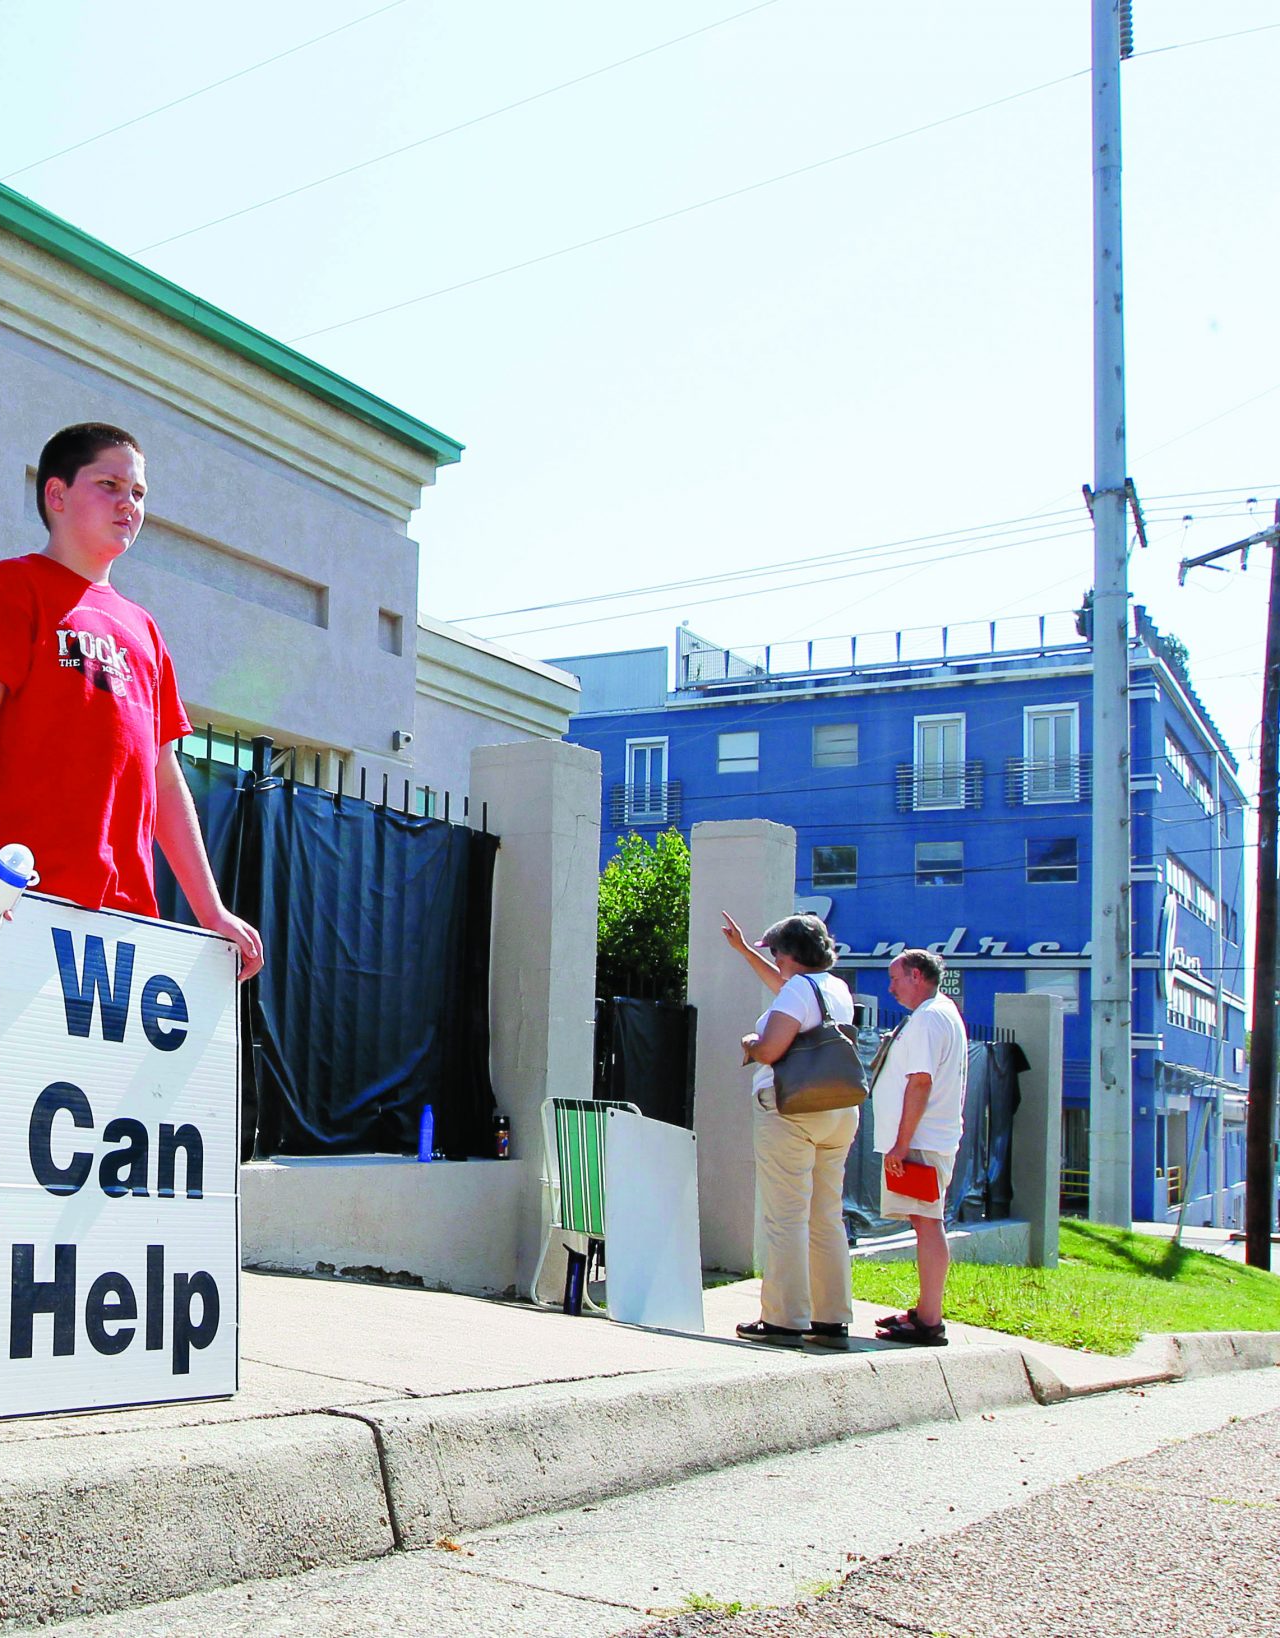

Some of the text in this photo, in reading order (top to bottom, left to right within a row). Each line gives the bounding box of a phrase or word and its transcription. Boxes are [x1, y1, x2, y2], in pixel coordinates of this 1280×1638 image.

[56, 629, 131, 674] rock
[58, 658, 81, 668] THE
[50, 926, 190, 1052] We
[939, 978, 960, 987] UP
[28, 1081, 204, 1200] Can
[9, 1243, 221, 1376] Help
